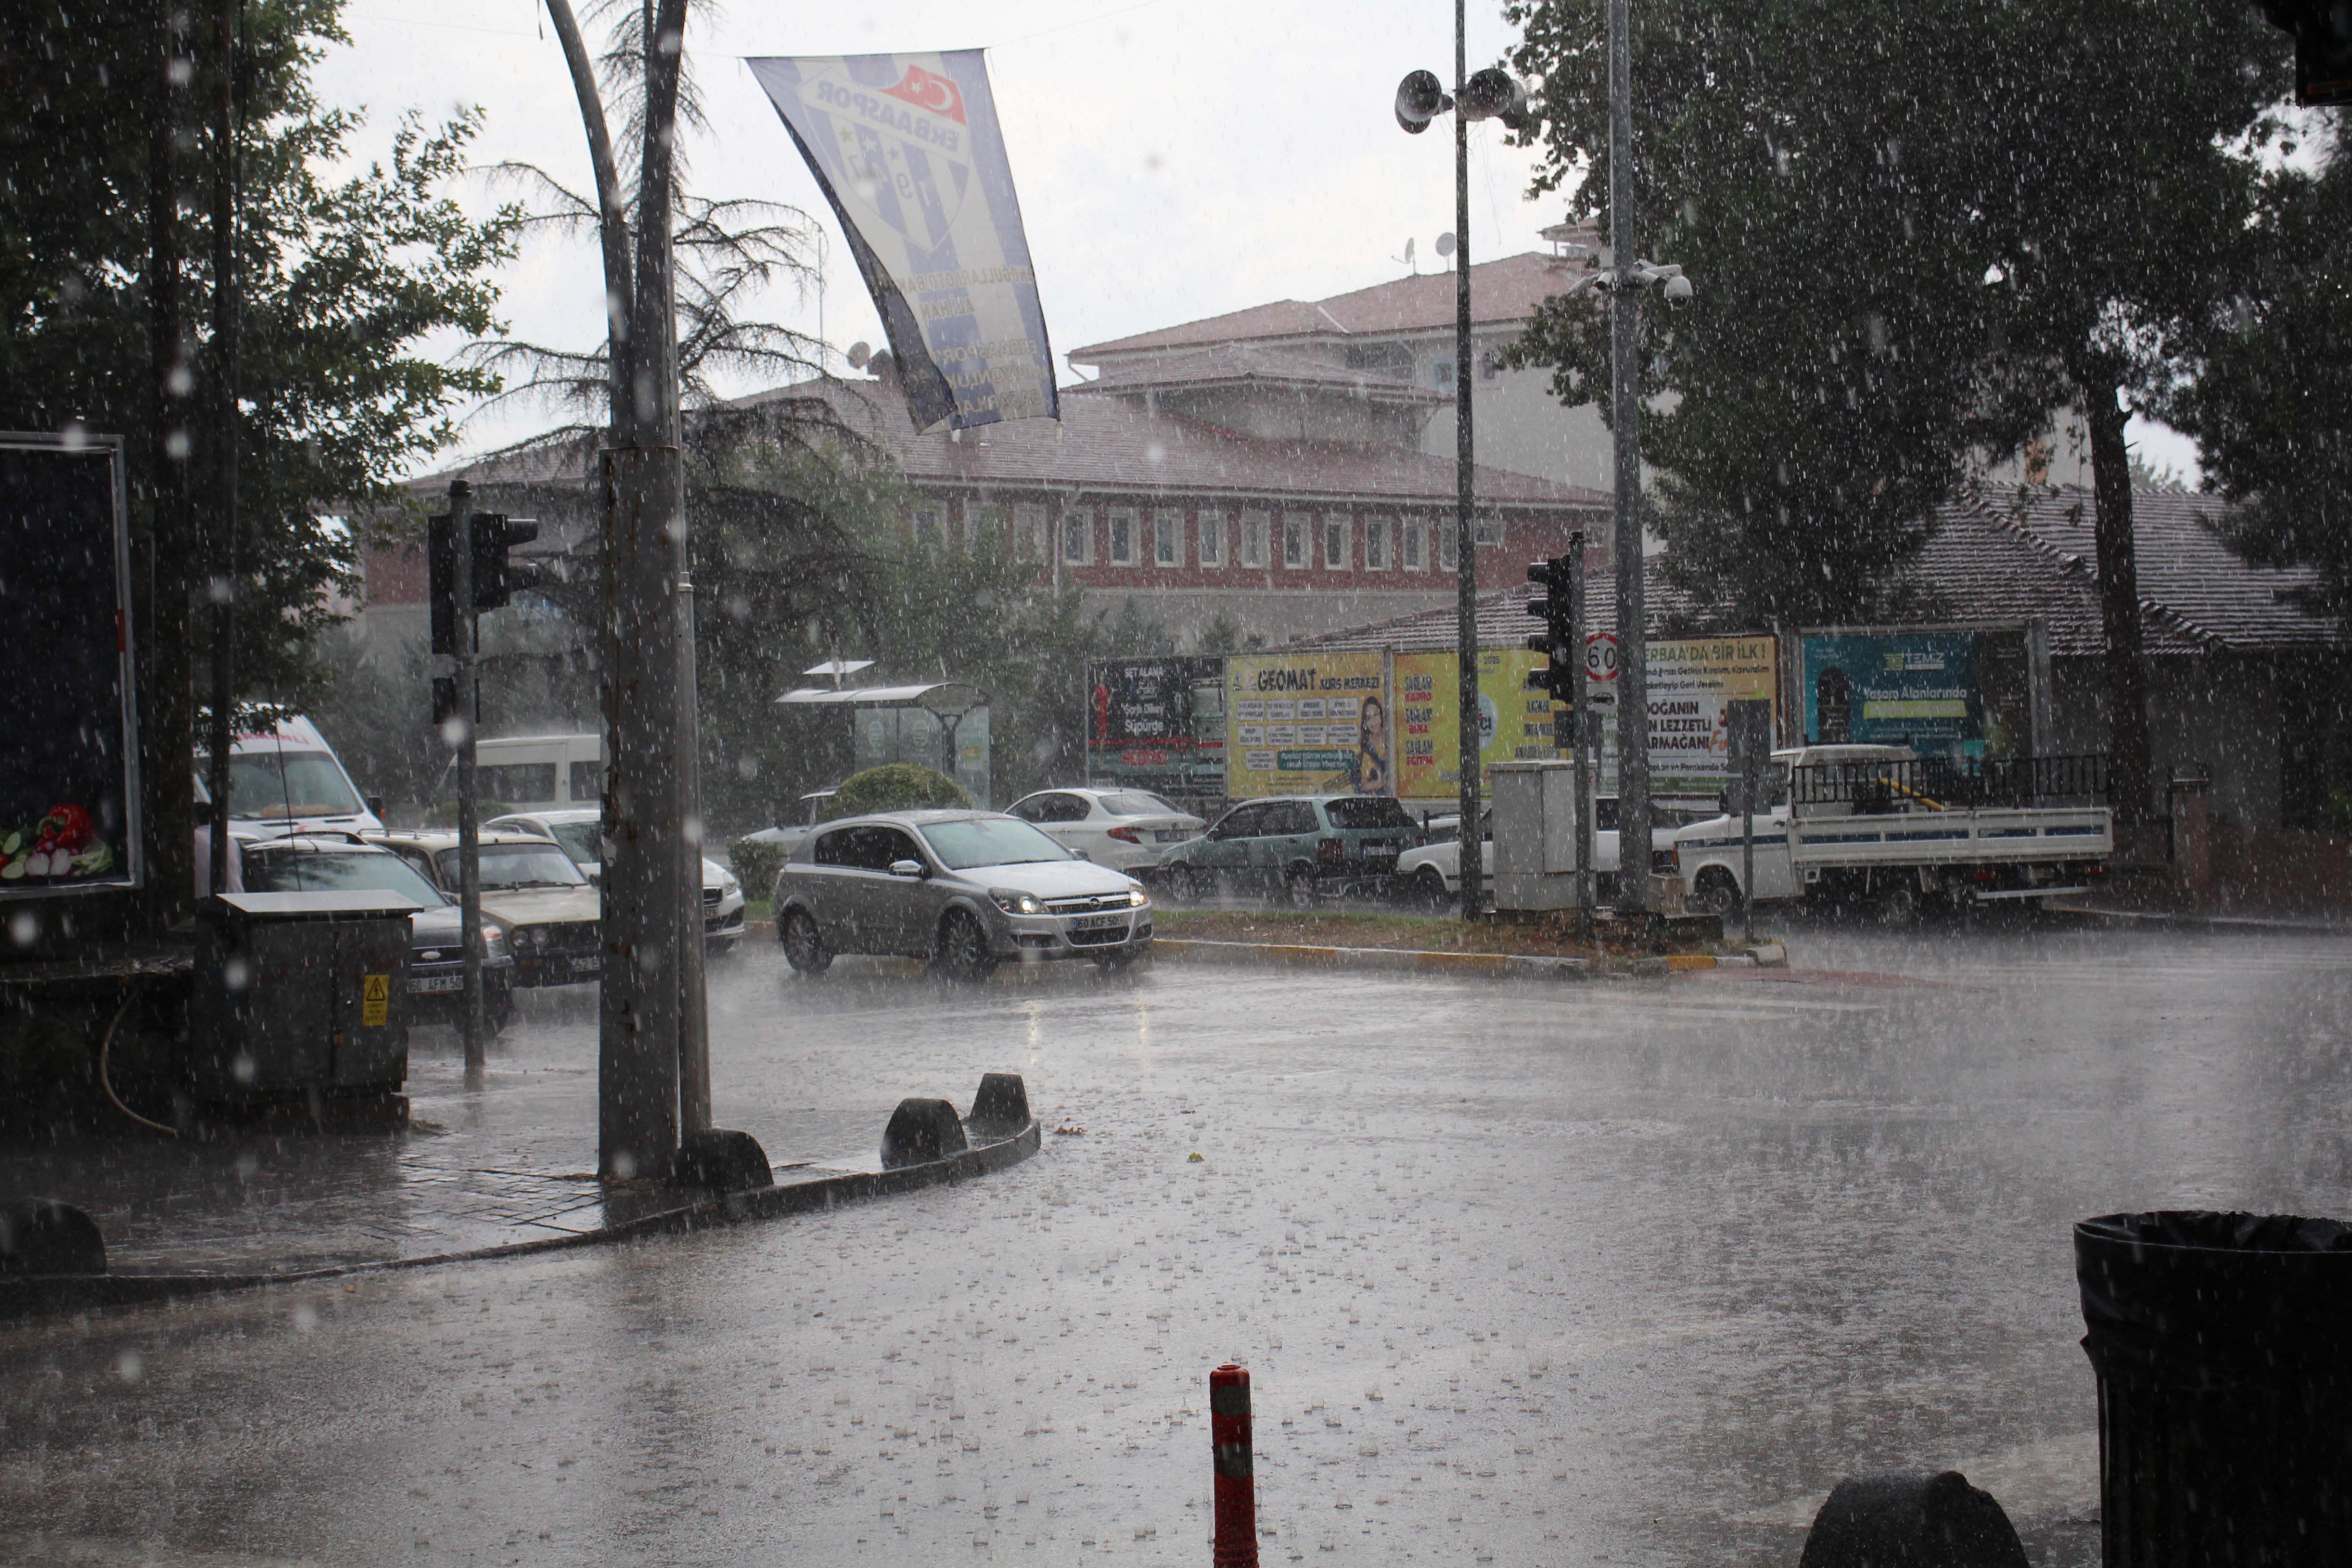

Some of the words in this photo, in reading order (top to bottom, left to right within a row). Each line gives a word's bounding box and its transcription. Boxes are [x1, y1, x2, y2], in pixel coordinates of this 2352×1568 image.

[1588, 646, 1616, 669] 60
[1713, 641, 1734, 660] BİR
[1737, 640, 1758, 658] İLK
[1258, 669, 1316, 692] GEOMAT
[1319, 678, 1342, 690] KURS
[1124, 719, 1163, 736] Süpürge
[1661, 715, 1712, 732] LEZZETLİ
[1078, 918, 1089, 929] 60
[1090, 917, 1106, 928] ACF
